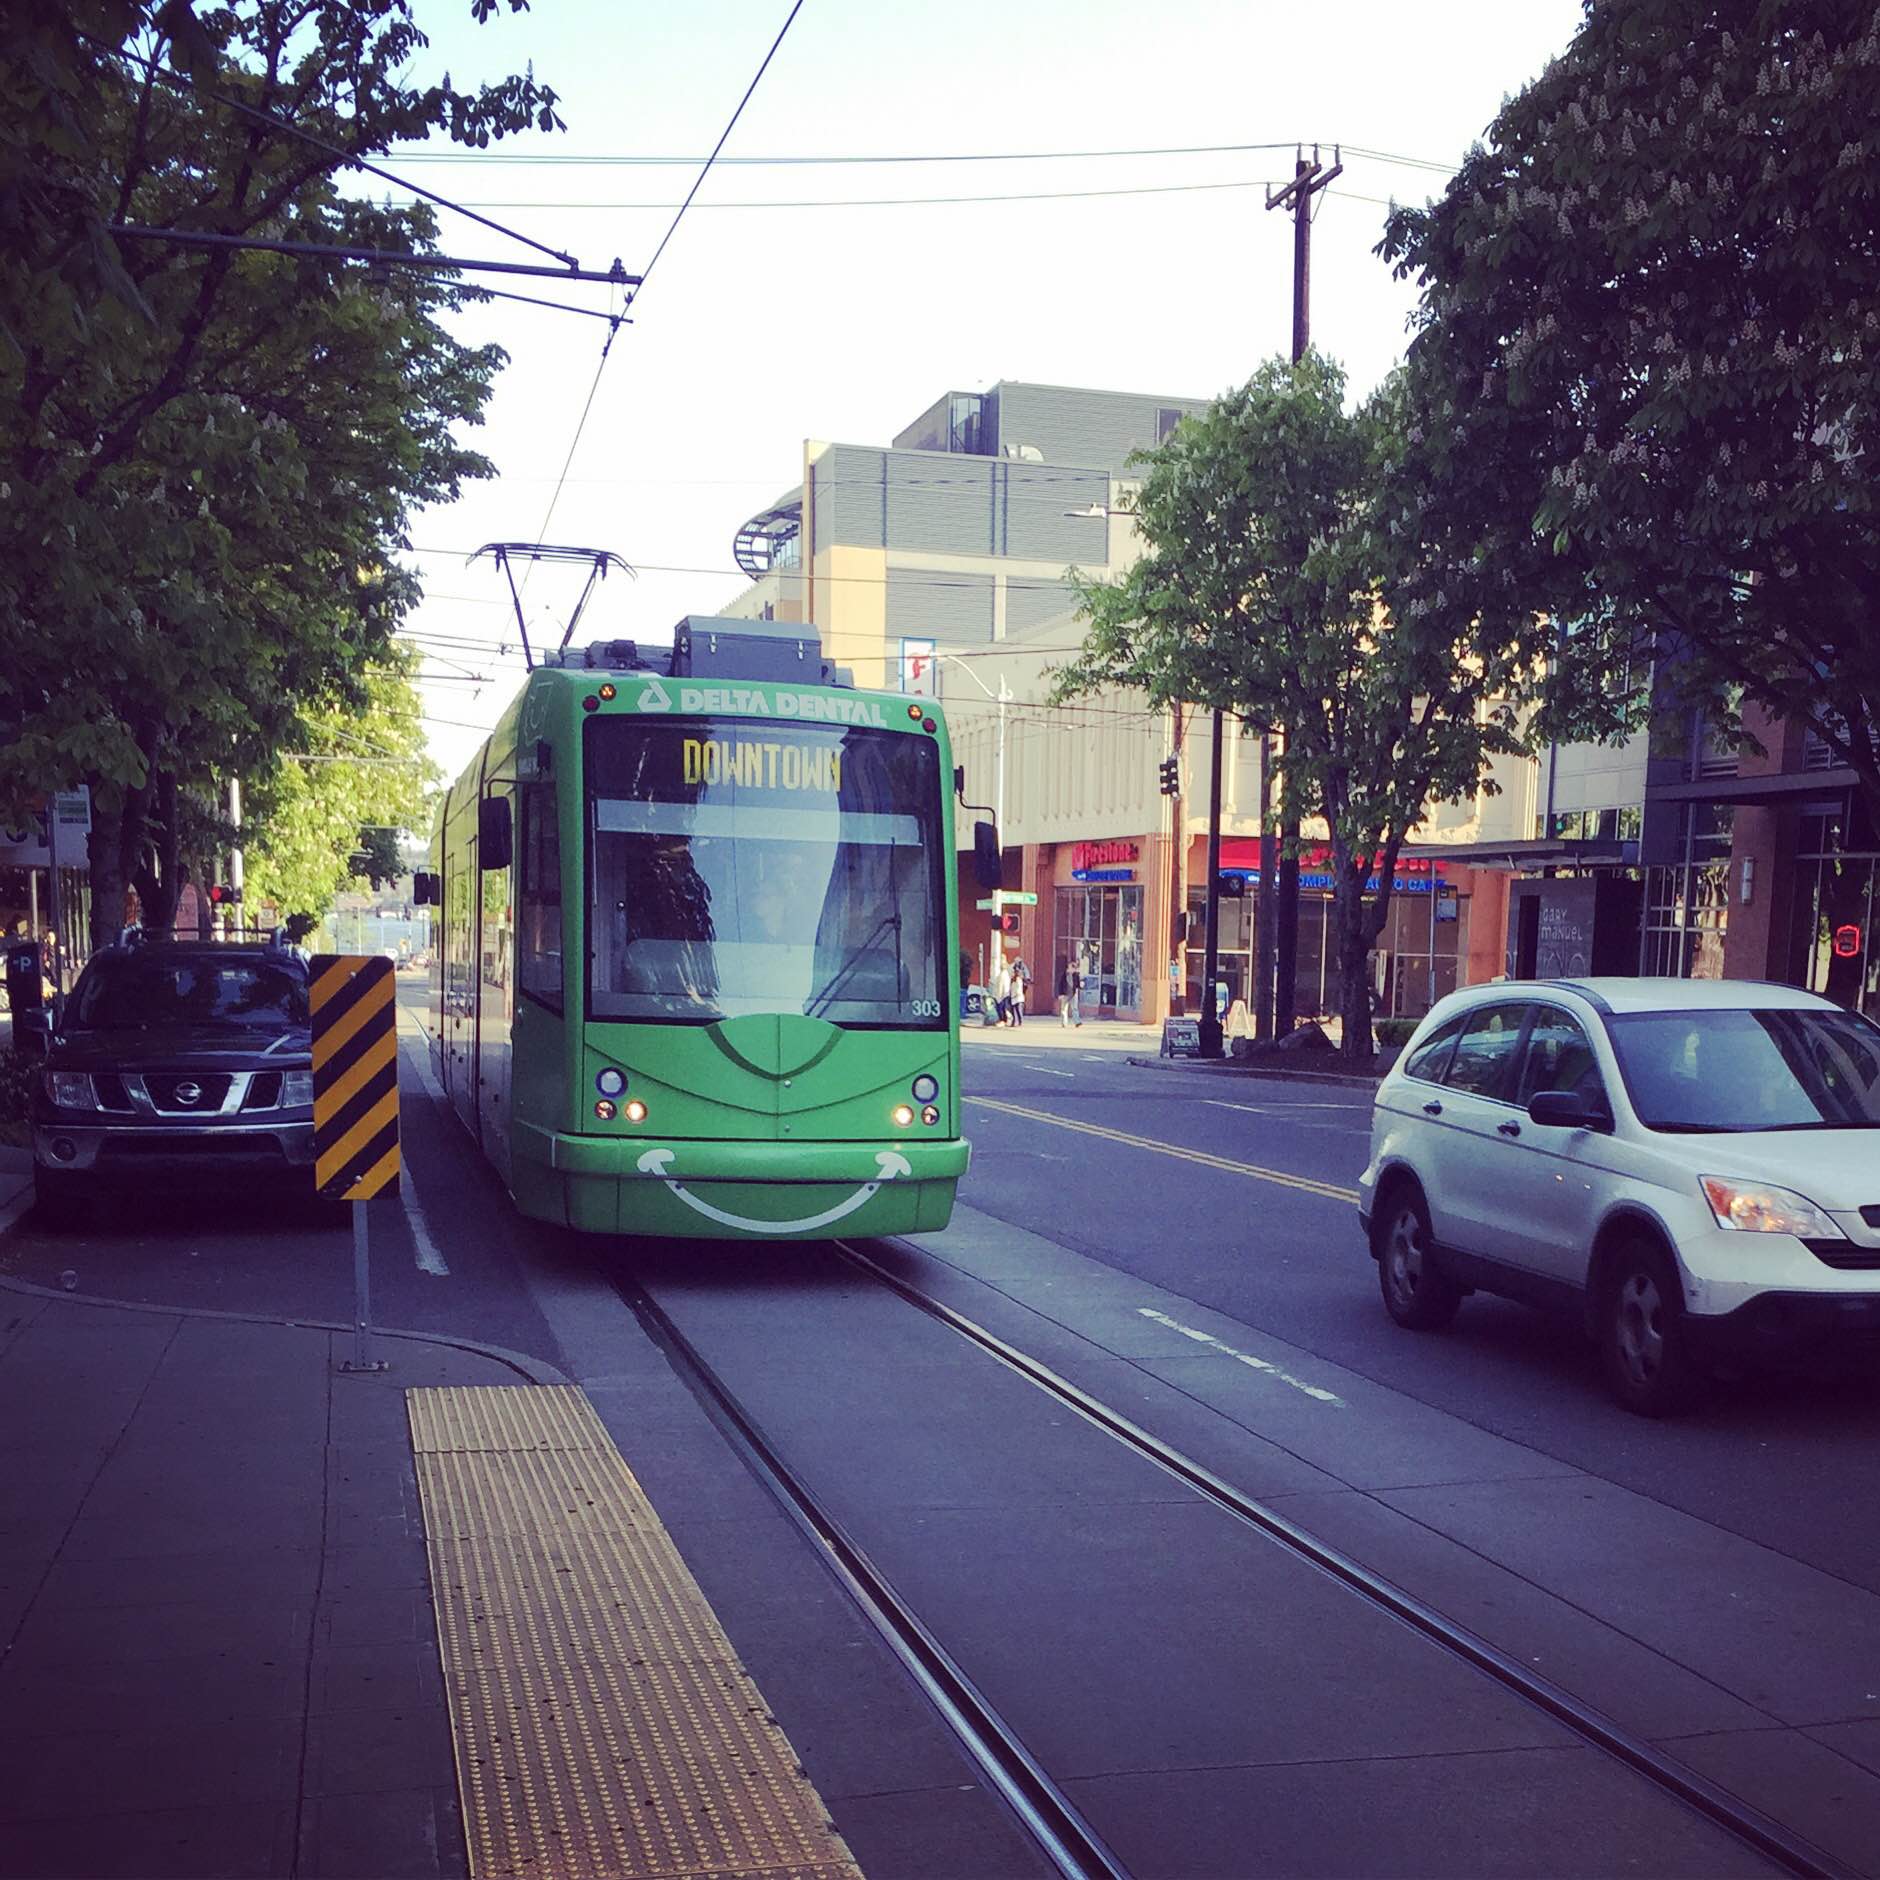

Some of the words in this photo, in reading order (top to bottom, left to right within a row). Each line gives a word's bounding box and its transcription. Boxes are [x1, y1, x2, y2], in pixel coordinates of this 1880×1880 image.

[680, 688, 770, 714] DELTA
[775, 691, 887, 727] DENTAL
[683, 738, 841, 792] DOWNTOWN
[911, 999, 941, 1017] 303
